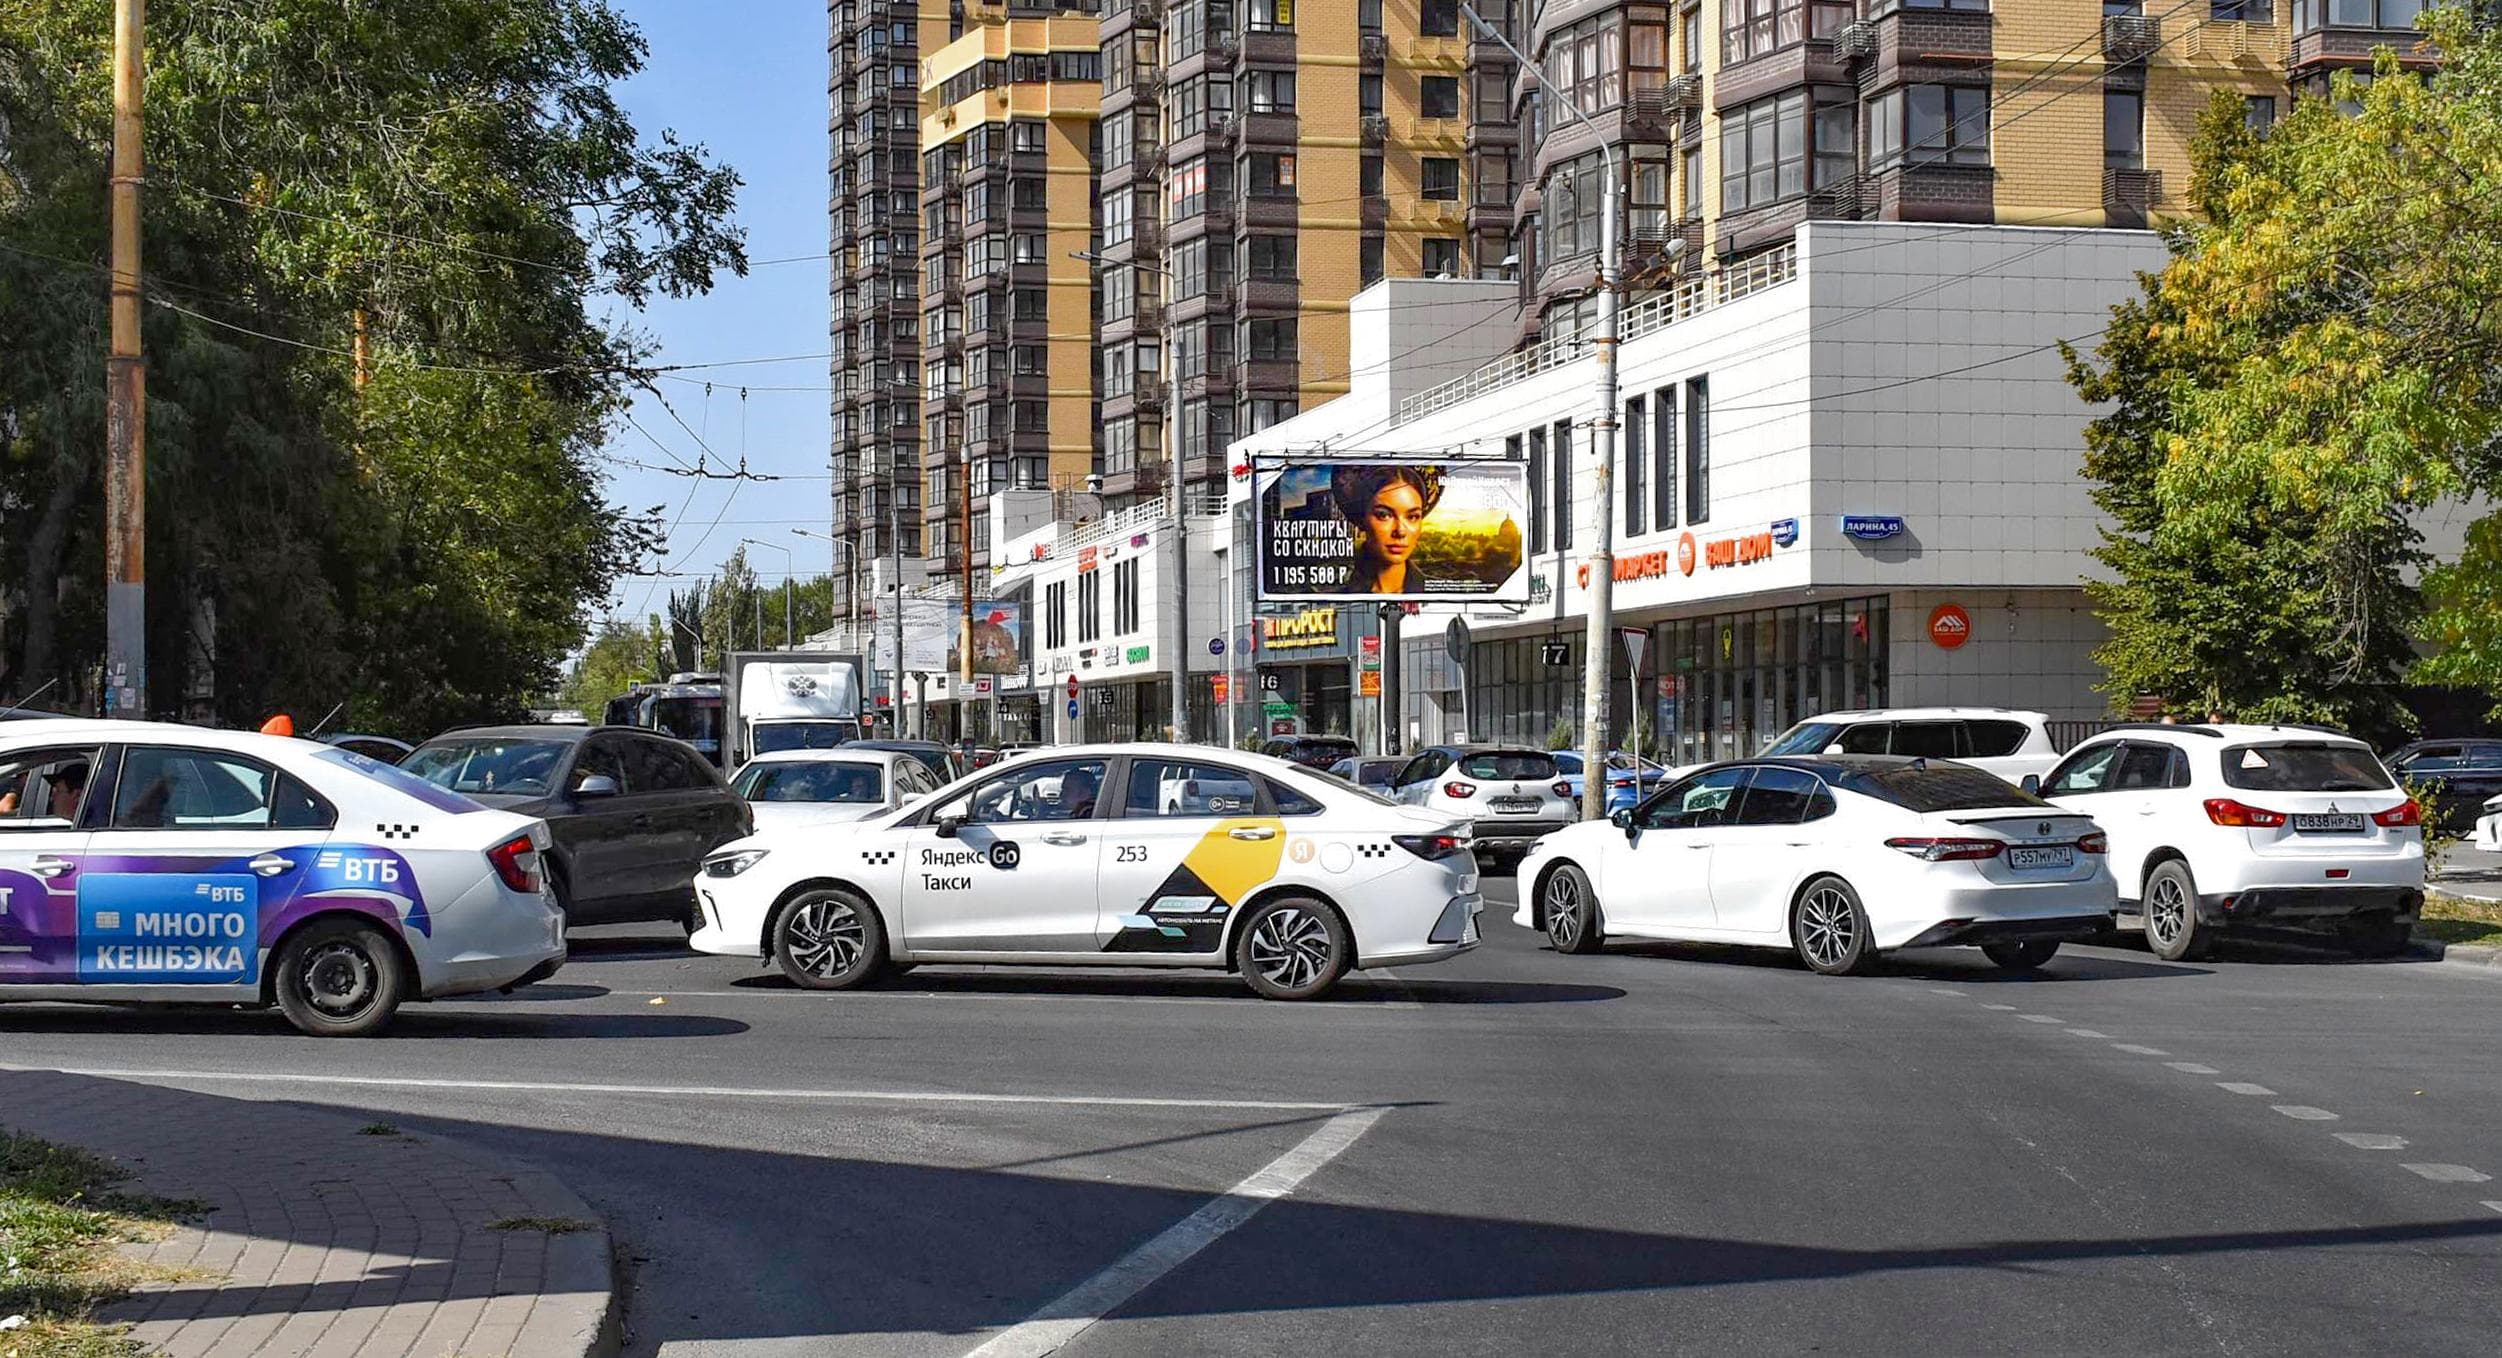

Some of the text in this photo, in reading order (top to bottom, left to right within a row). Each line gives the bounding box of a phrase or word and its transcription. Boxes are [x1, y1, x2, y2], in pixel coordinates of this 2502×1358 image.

[1273, 520, 1347, 538] КВАРТИРЫ
[1273, 537, 1354, 558] СО СКИДКОЙ
[1706, 532, 1772, 568] ВАШ ДОМ
[1273, 566, 1279, 585] 1
[1283, 566, 1306, 585] 195
[921, 846, 1017, 867] Яндекс Go
[1116, 845, 1148, 862] 253
[344, 858, 399, 882] ВТБ
[922, 874, 971, 890] Такси
[211, 887, 245, 902] ВТБ
[135, 913, 245, 937] МНОГО
[97, 945, 245, 970] КЕШБЭКА
